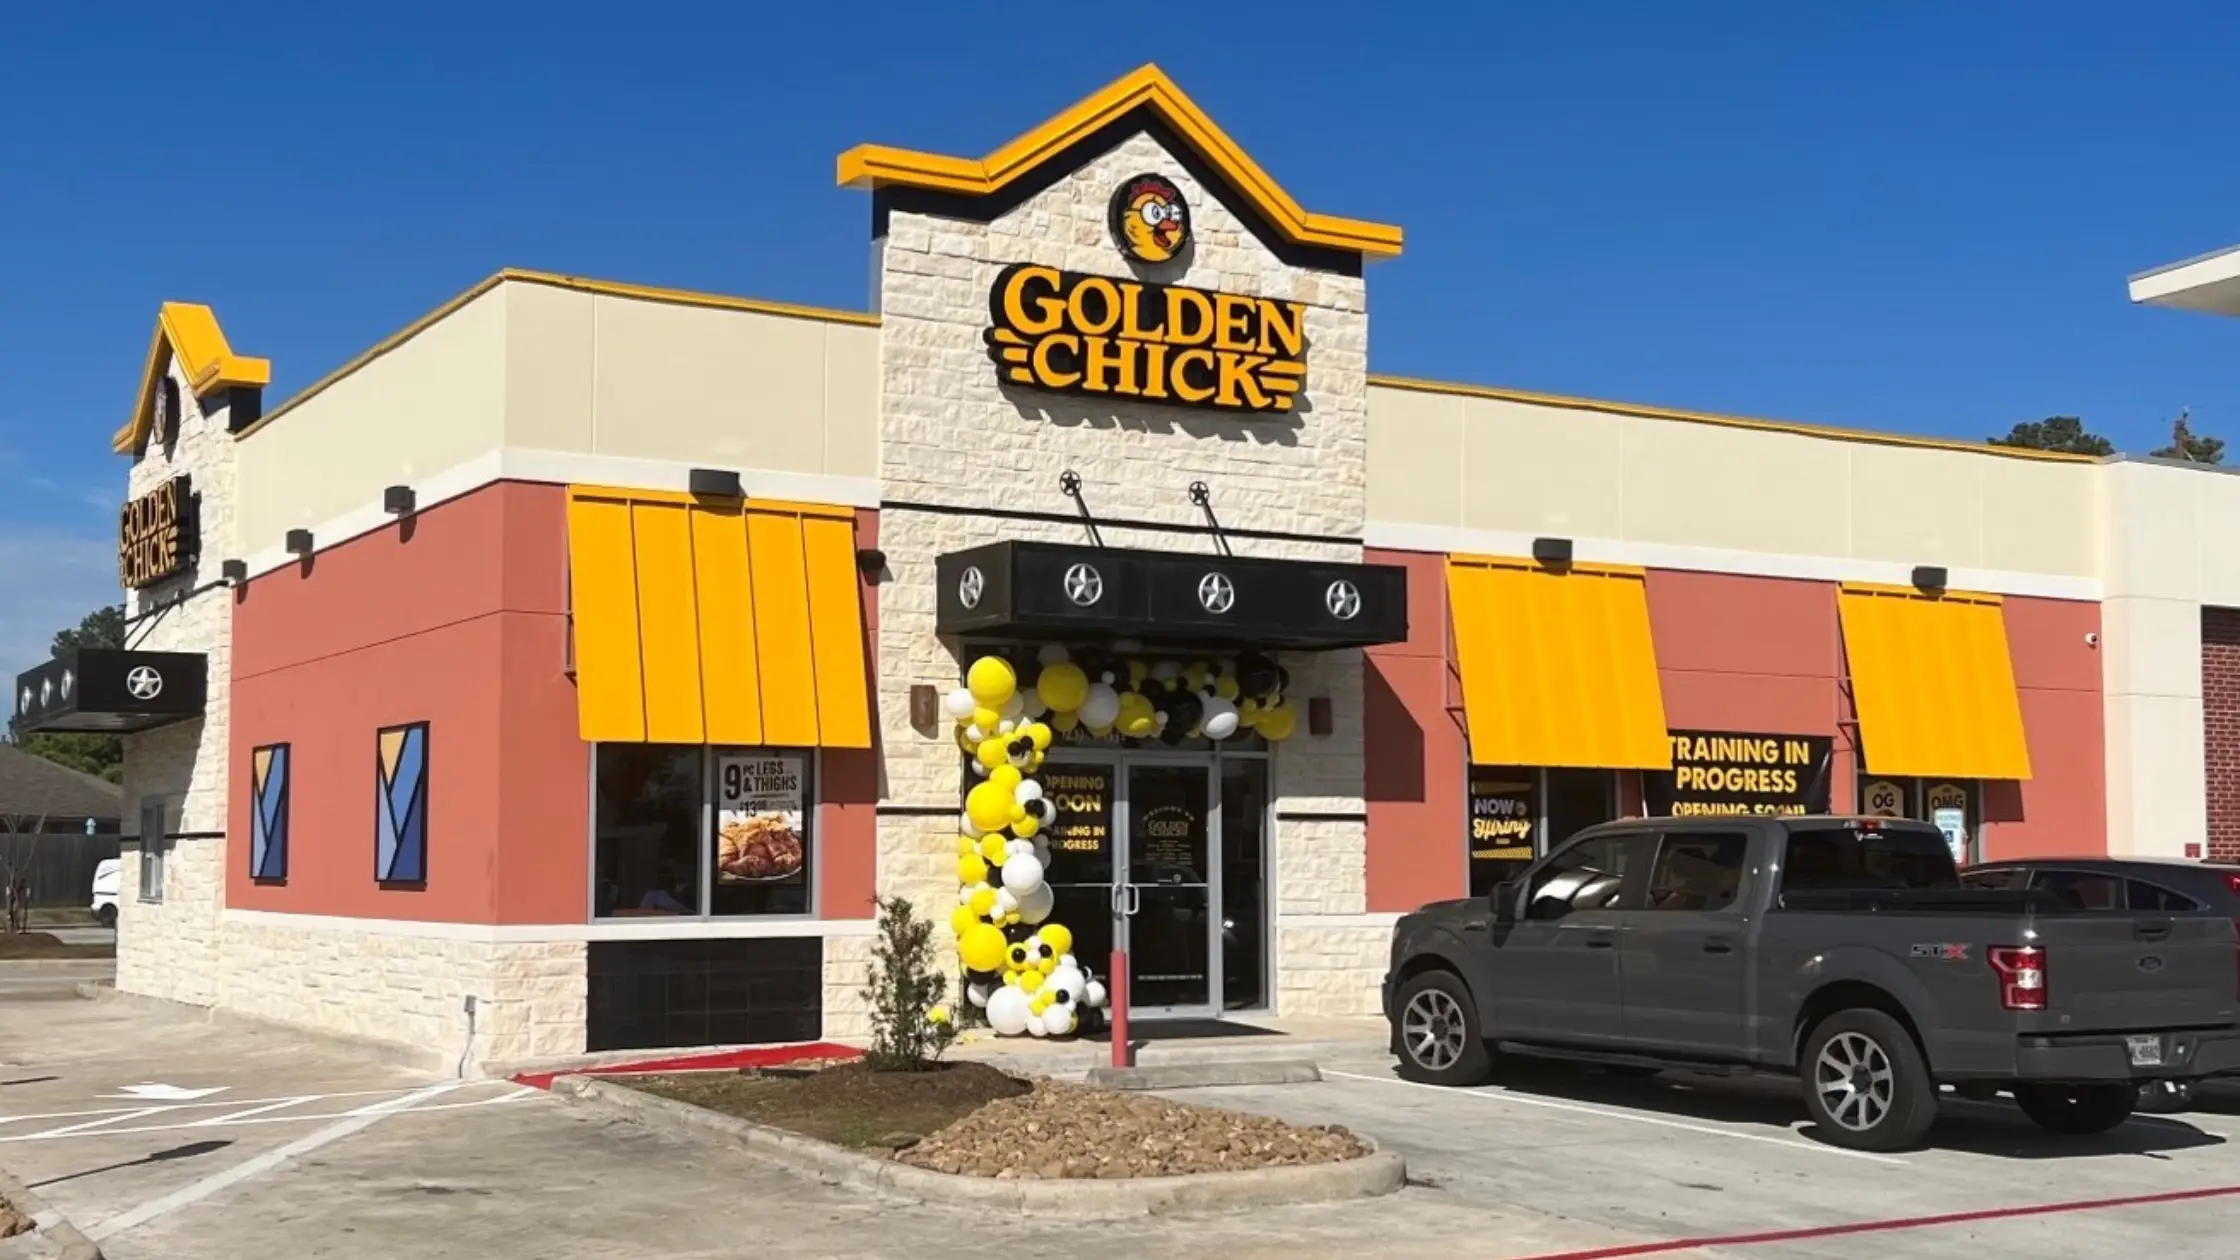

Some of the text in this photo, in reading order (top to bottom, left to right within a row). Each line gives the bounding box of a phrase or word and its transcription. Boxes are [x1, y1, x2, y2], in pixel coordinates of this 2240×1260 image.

[1004, 266, 1307, 357] GOLDEN
[1032, 333, 1272, 408] CHICK
[121, 479, 177, 554] GOLDEN
[126, 528, 171, 588] CHICK
[1667, 736, 1810, 765] TRAINING IN
[724, 764, 741, 800] 9
[756, 761, 784, 776] LEGS
[754, 775, 797, 792] THIGHS
[1676, 766, 1797, 793] PROGRESS
[1474, 799, 1514, 814] NOW
[1672, 801, 1750, 816] OPENING
[1873, 792, 1895, 808] OG
[1093, 825, 1106, 837] IN
[1473, 815, 1532, 840] Hiring
